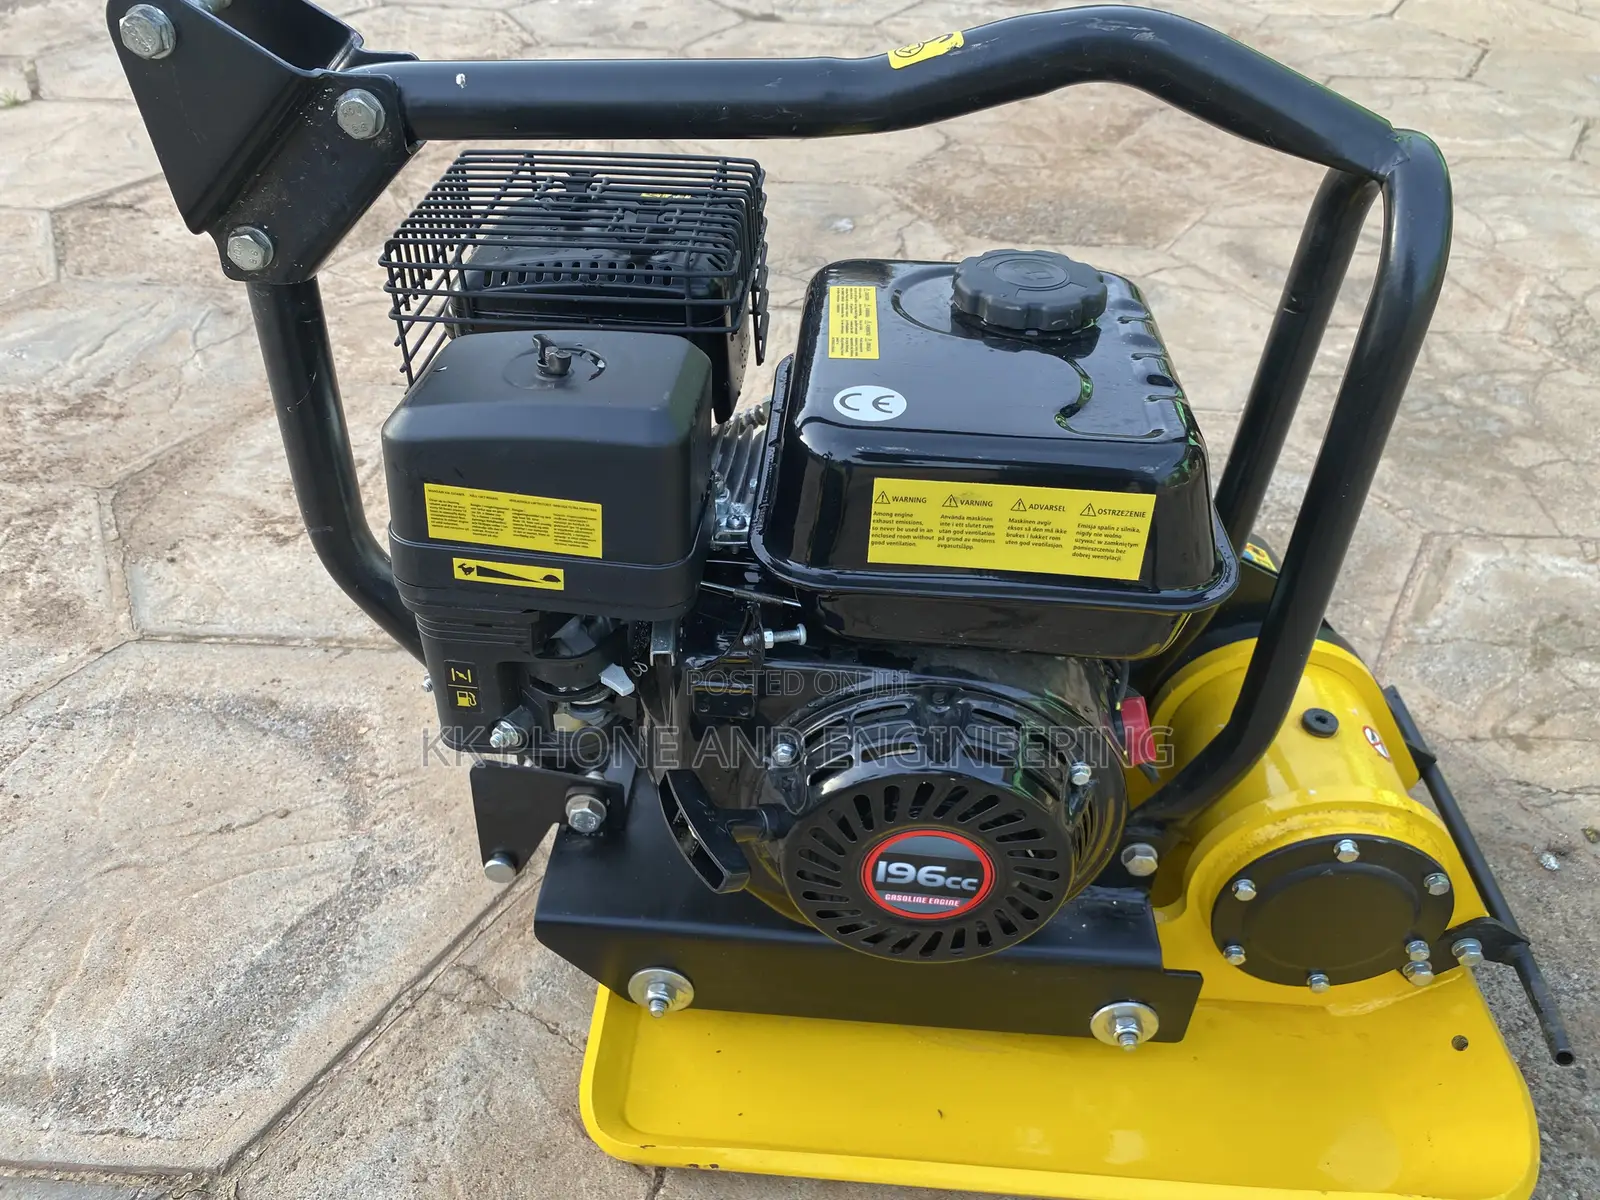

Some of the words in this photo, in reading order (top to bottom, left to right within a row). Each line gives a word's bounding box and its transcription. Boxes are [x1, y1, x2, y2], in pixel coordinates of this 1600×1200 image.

[839, 393, 895, 413] CE
[892, 496, 927, 504] WARNING
[960, 499, 993, 507] VARNING
[1028, 503, 1066, 512] ADVARSEL
[1103, 540, 1139, 548] zamkniętym
[1073, 545, 1115, 553] pomieszczeniu
[1072, 551, 1091, 559] dobrej
[876, 860, 979, 891] 196cc
[885, 893, 929, 905] GASOLINE
[929, 896, 961, 907] ENGINE
